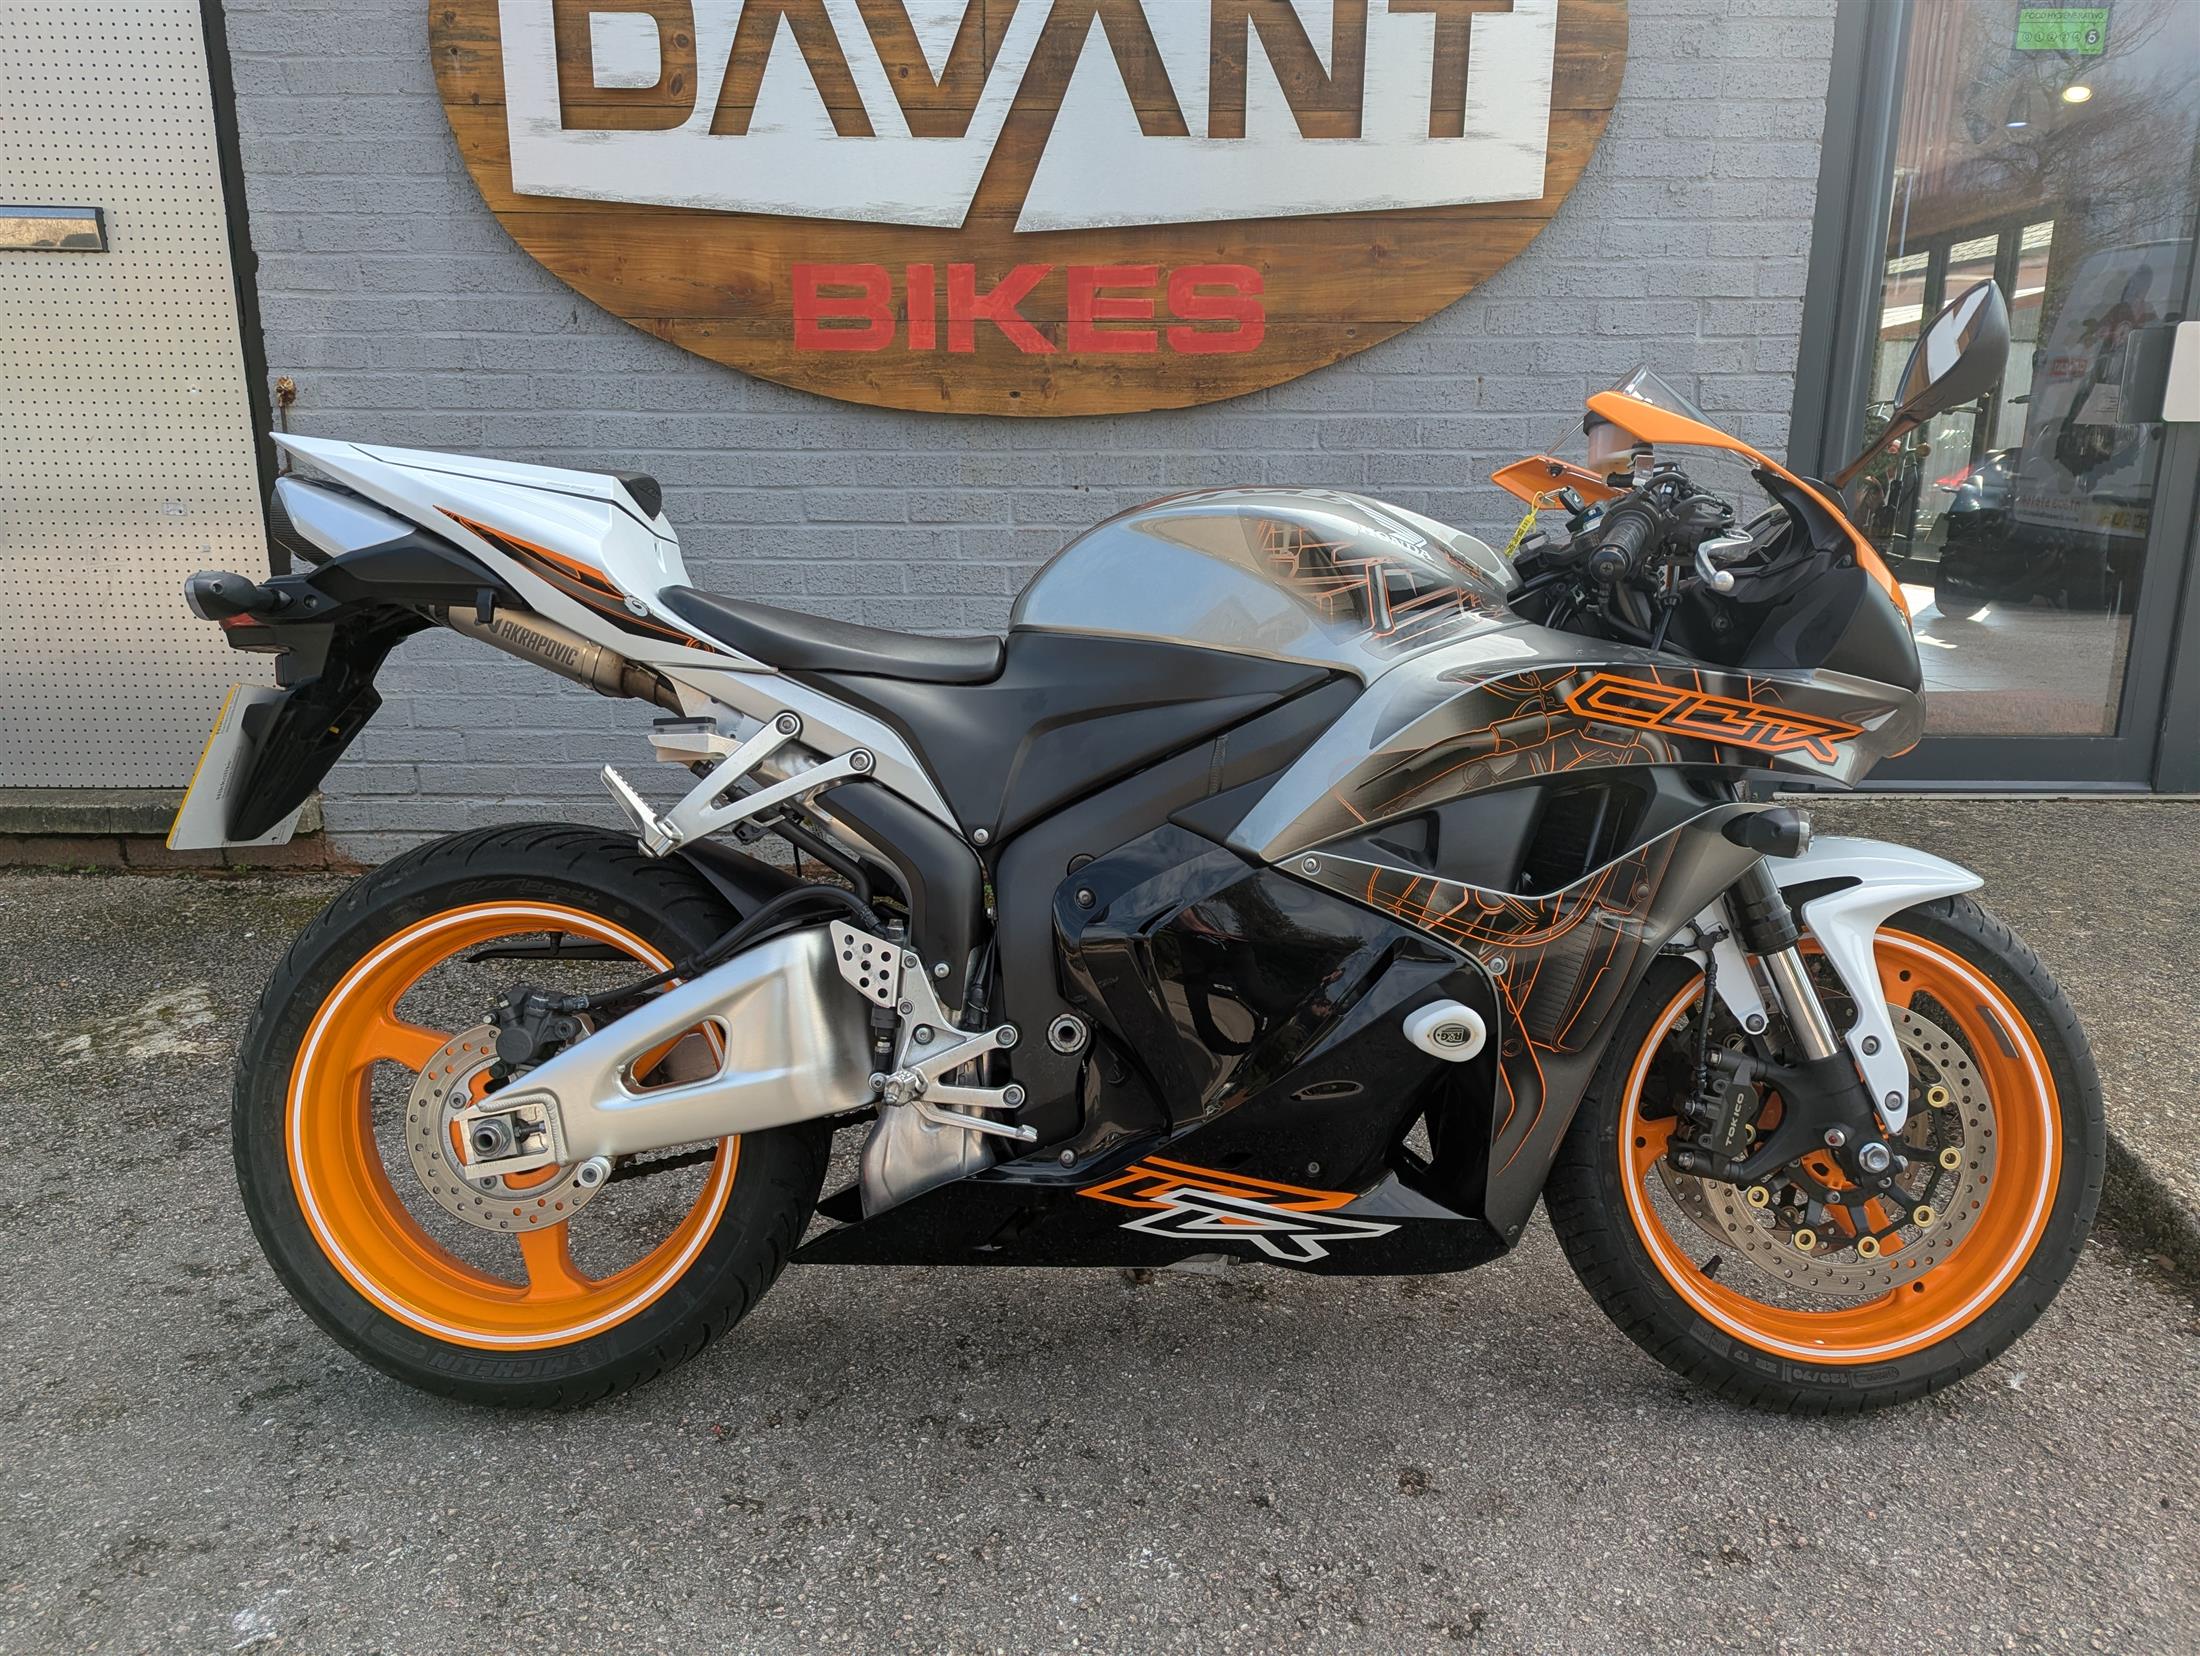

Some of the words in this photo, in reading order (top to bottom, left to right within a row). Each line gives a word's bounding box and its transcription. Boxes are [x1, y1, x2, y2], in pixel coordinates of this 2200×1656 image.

[2088, 31, 2097, 43] 5
[554, 0, 1514, 139] DAVANT
[792, 263, 1266, 354] BIKES
[1725, 1093, 1745, 1146] TOKICO
[1792, 1367, 1848, 1385] 120/70
